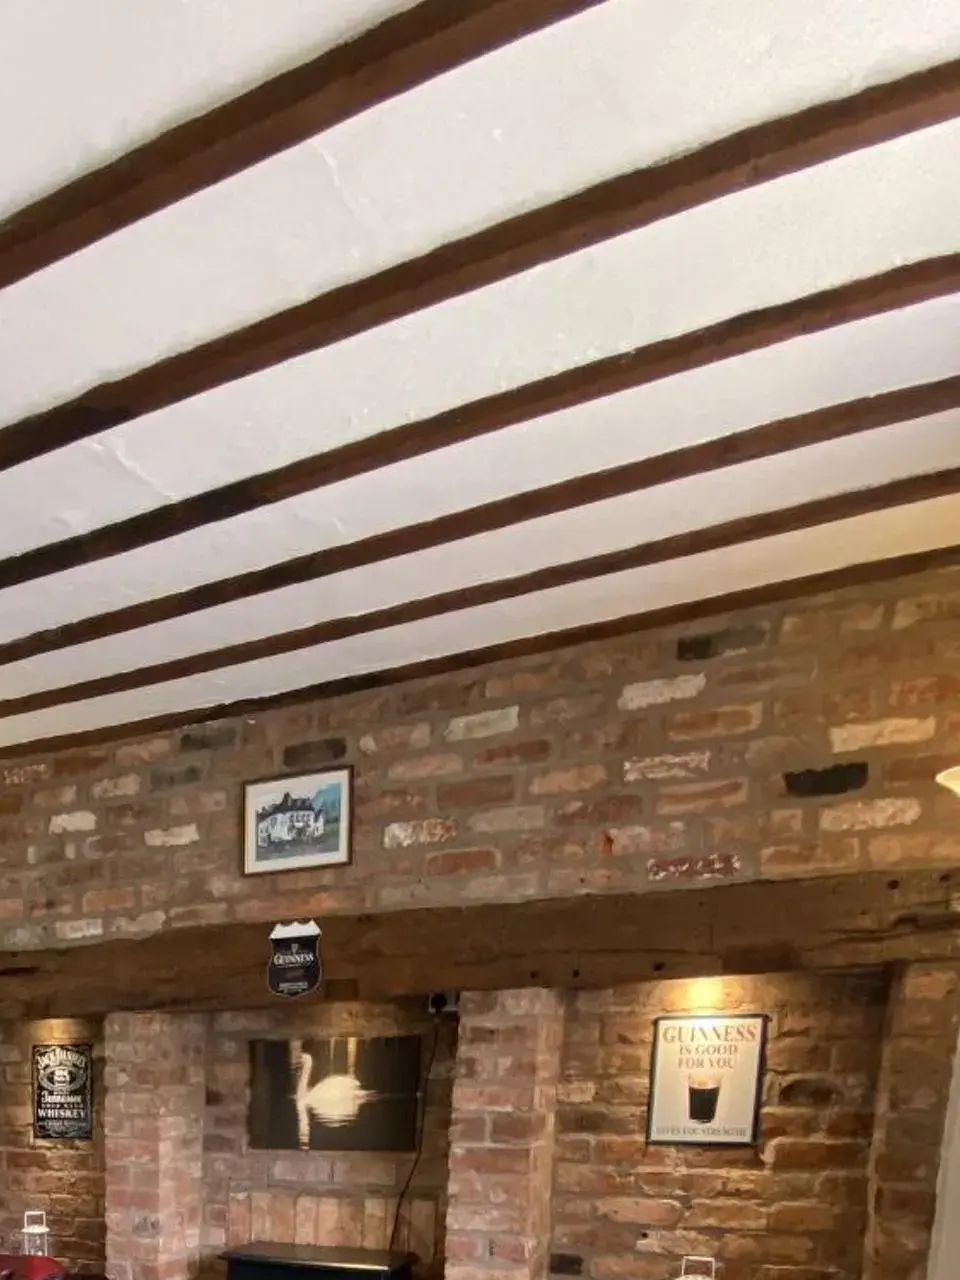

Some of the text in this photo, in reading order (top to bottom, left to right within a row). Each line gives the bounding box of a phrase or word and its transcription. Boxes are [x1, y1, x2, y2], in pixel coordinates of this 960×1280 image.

[273, 952, 314, 965] GUINNESS
[662, 1024, 757, 1043] GUINNESS
[679, 1043, 738, 1055] IS GOOD
[677, 1056, 736, 1069] FOR YOU
[37, 1108, 86, 1119] WHISKEY
